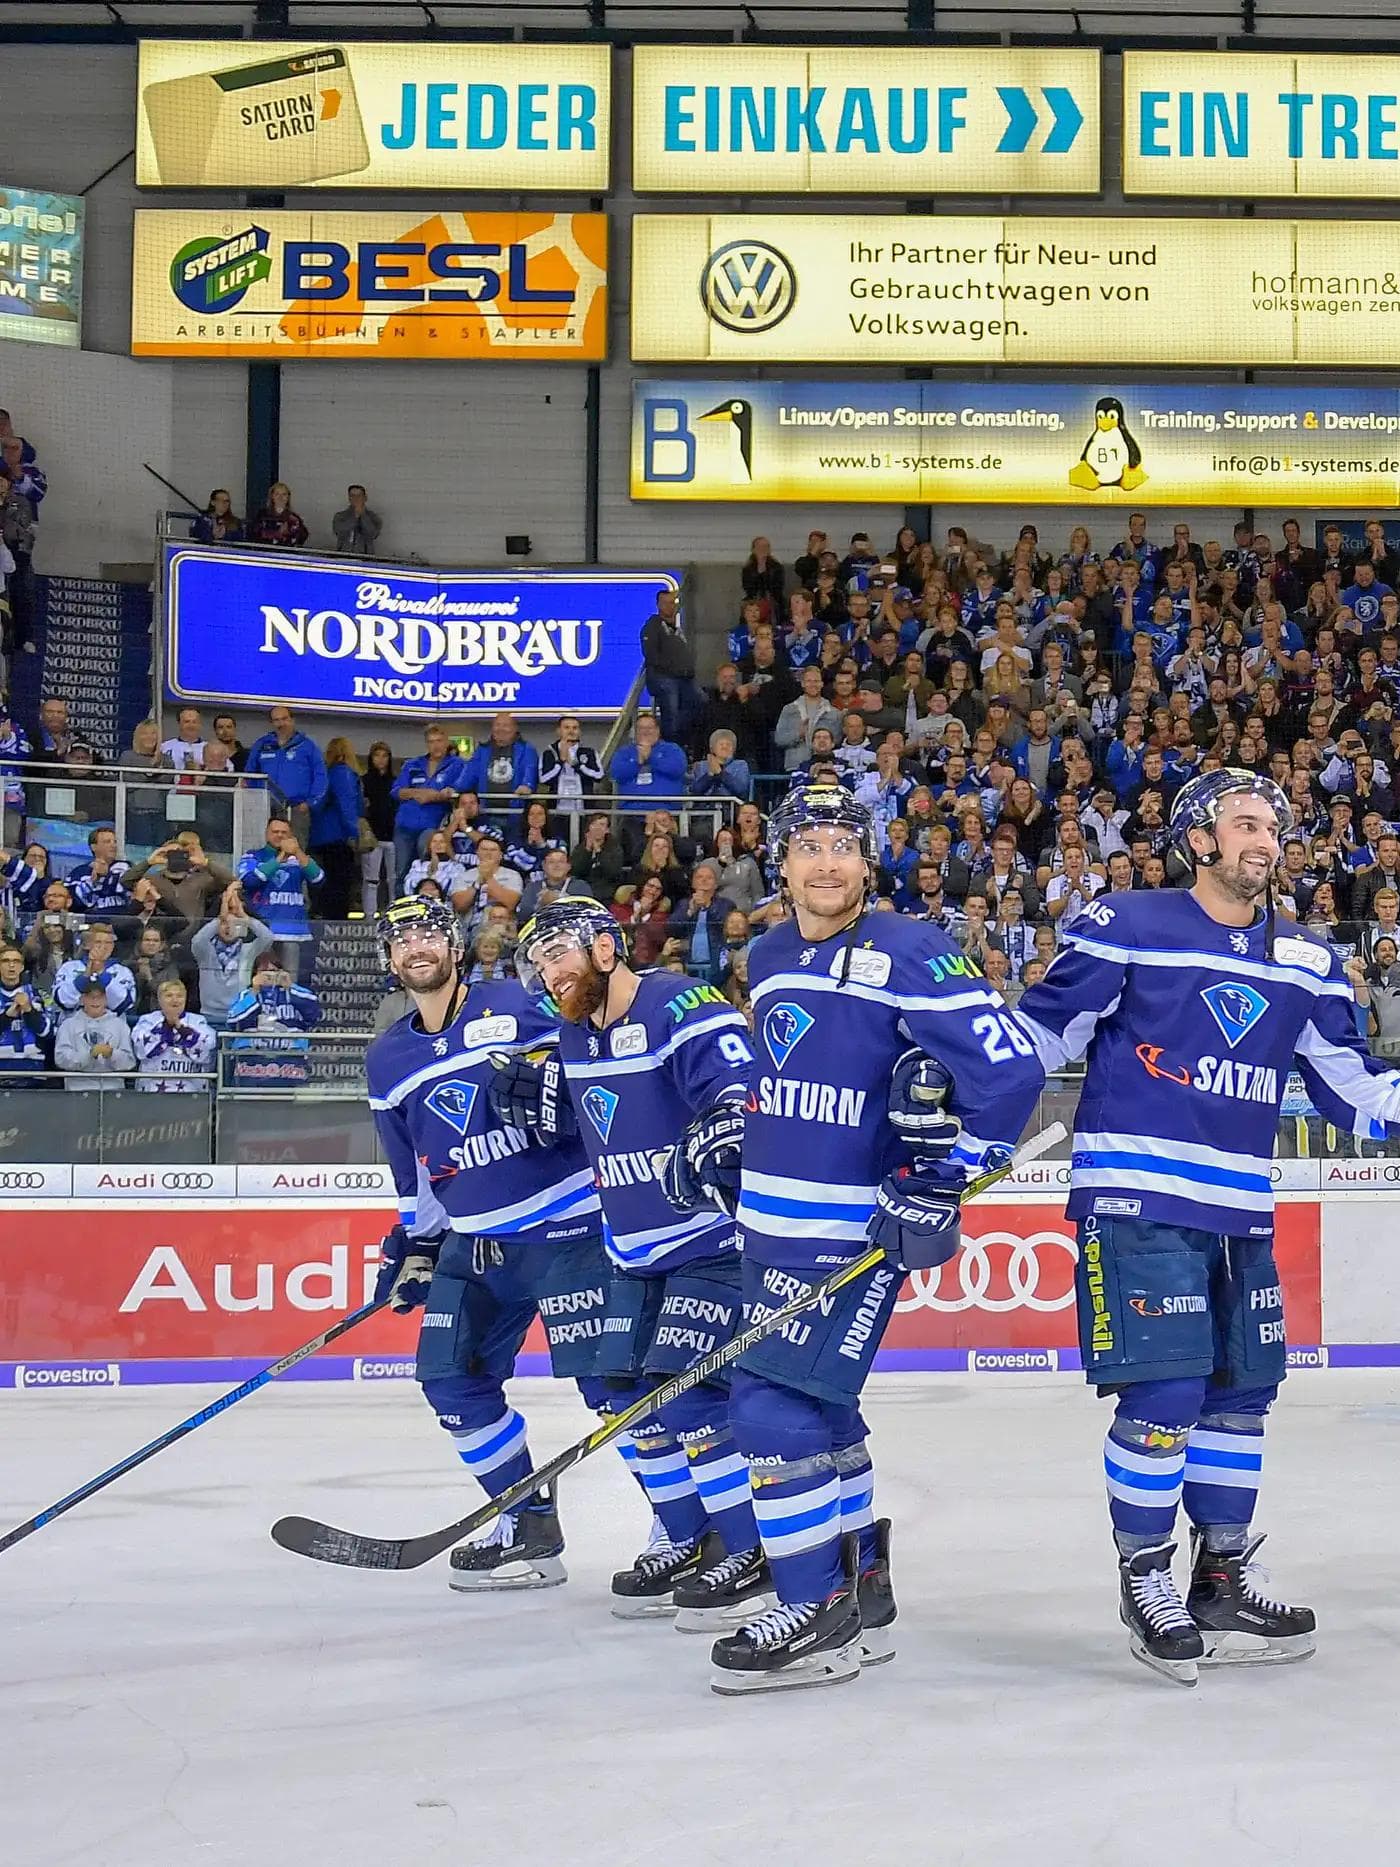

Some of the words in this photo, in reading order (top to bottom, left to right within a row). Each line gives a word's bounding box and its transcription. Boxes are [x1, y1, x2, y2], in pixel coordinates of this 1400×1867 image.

[240, 94, 314, 126] SATURN
[381, 83, 596, 151] JEDER
[664, 85, 967, 153] EINKAUF
[1139, 91, 1248, 158] EIN
[266, 114, 315, 141] CARD
[184, 231, 257, 281] SYSTEM
[849, 242, 884, 266] Ihr
[891, 242, 987, 266] Partner
[994, 242, 1031, 266] für
[1037, 244, 1100, 267] Neu-
[1108, 244, 1157, 267] und
[219, 260, 258, 293] LIFT
[283, 241, 575, 302] BESL
[849, 278, 1091, 305] Gebrauchtwagen
[1100, 283, 1149, 302] von
[1252, 298, 1362, 314] volkswagen
[428, 326, 439, 339] &
[461, 326, 578, 341] STAPLER
[849, 313, 1029, 340] Volkswagen.
[779, 406, 889, 428] Linux/Open
[893, 409, 957, 426] Source
[960, 408, 1065, 431] Consulting,
[1140, 410, 1221, 432] Training,
[1224, 411, 1297, 432] Support
[1302, 412, 1319, 430] &
[818, 454, 1003, 472] www.b1-systems.de
[1211, 454, 1400, 476] info@b1-systems.de
[355, 580, 520, 617] Privatbrauerei
[258, 606, 603, 676] NORDBRÄU
[353, 676, 520, 703] INGOLSTADT
[541, 1060, 560, 1133] BAUER
[758, 1075, 867, 1128] SATURN
[97, 1173, 155, 1189] Audi
[272, 1173, 328, 1188] Audi
[999, 1169, 1051, 1184] Audi
[1327, 1166, 1378, 1182] Audi
[118, 1245, 382, 1313] Audi
[539, 1288, 605, 1317] HERRN
[660, 1295, 733, 1327] HERRN
[838, 1269, 894, 1361] SATURN
[548, 1316, 603, 1346] BRÄU
[655, 1326, 716, 1353] BRÄU
[276, 1341, 319, 1373] NEXUS
